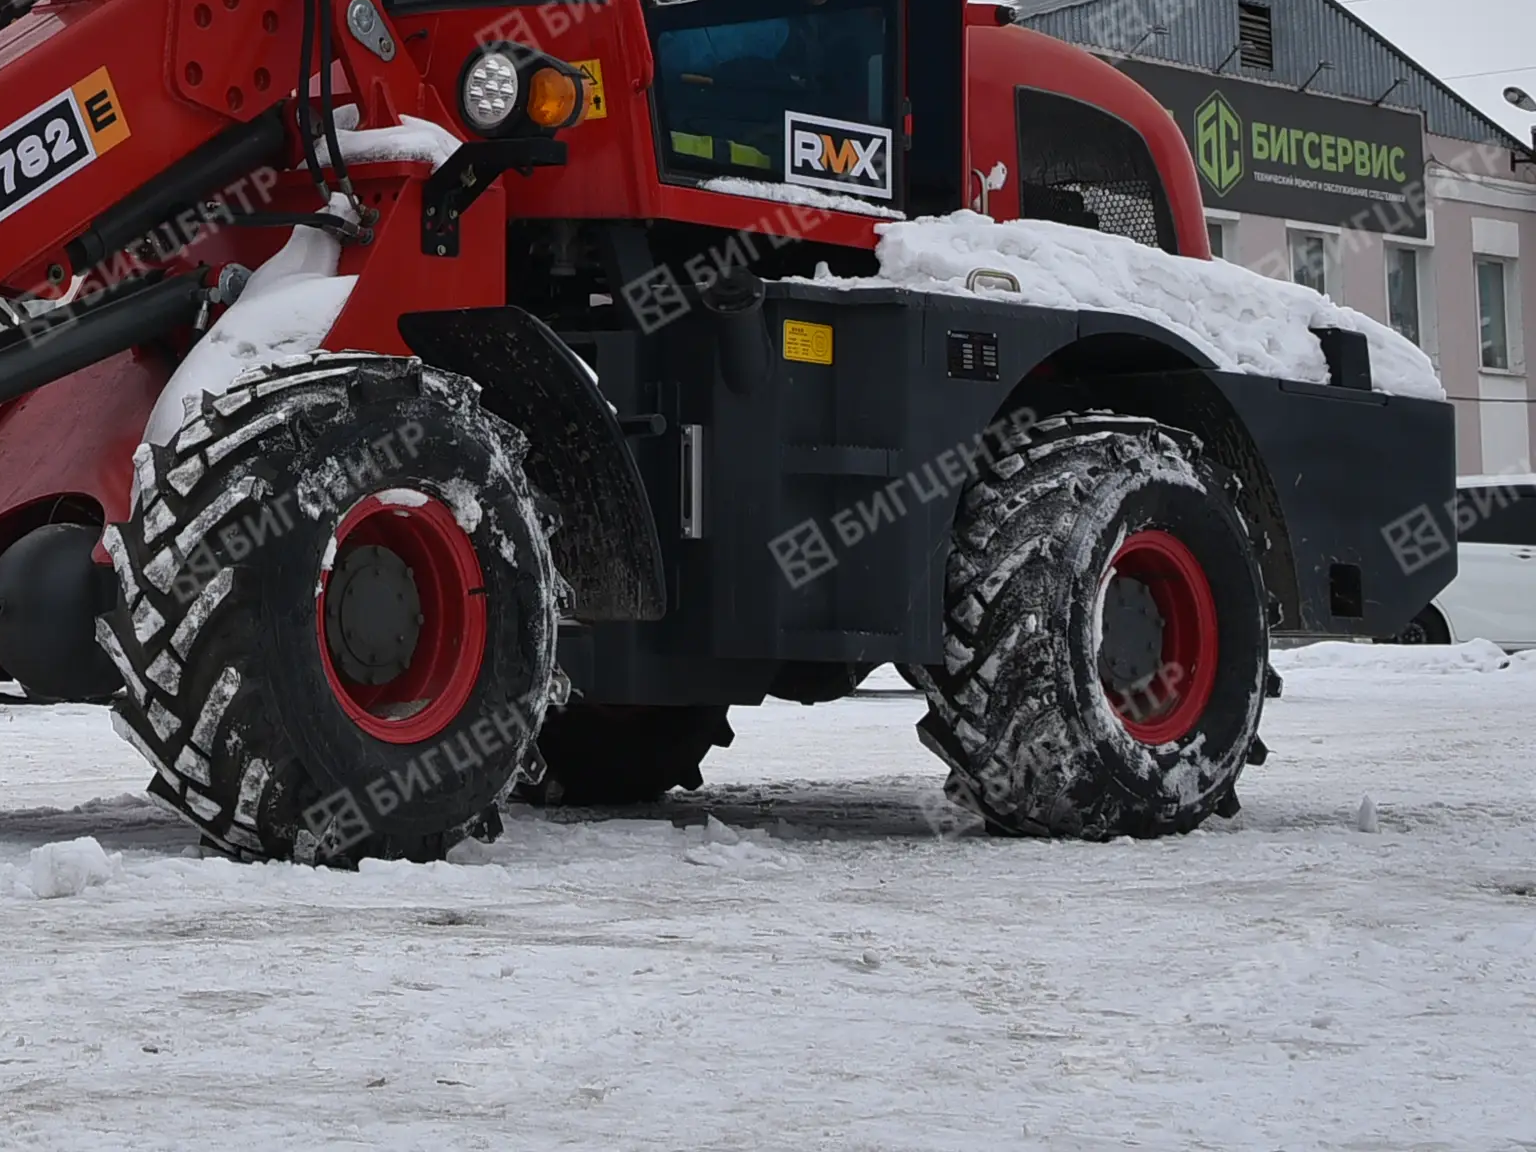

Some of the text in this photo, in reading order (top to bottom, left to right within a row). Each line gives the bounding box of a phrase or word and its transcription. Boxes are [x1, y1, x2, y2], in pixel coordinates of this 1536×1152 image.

[84, 89, 117, 133] E
[794, 130, 883, 181] RMX
[1252, 122, 1406, 183] БИГСЕРВИС
